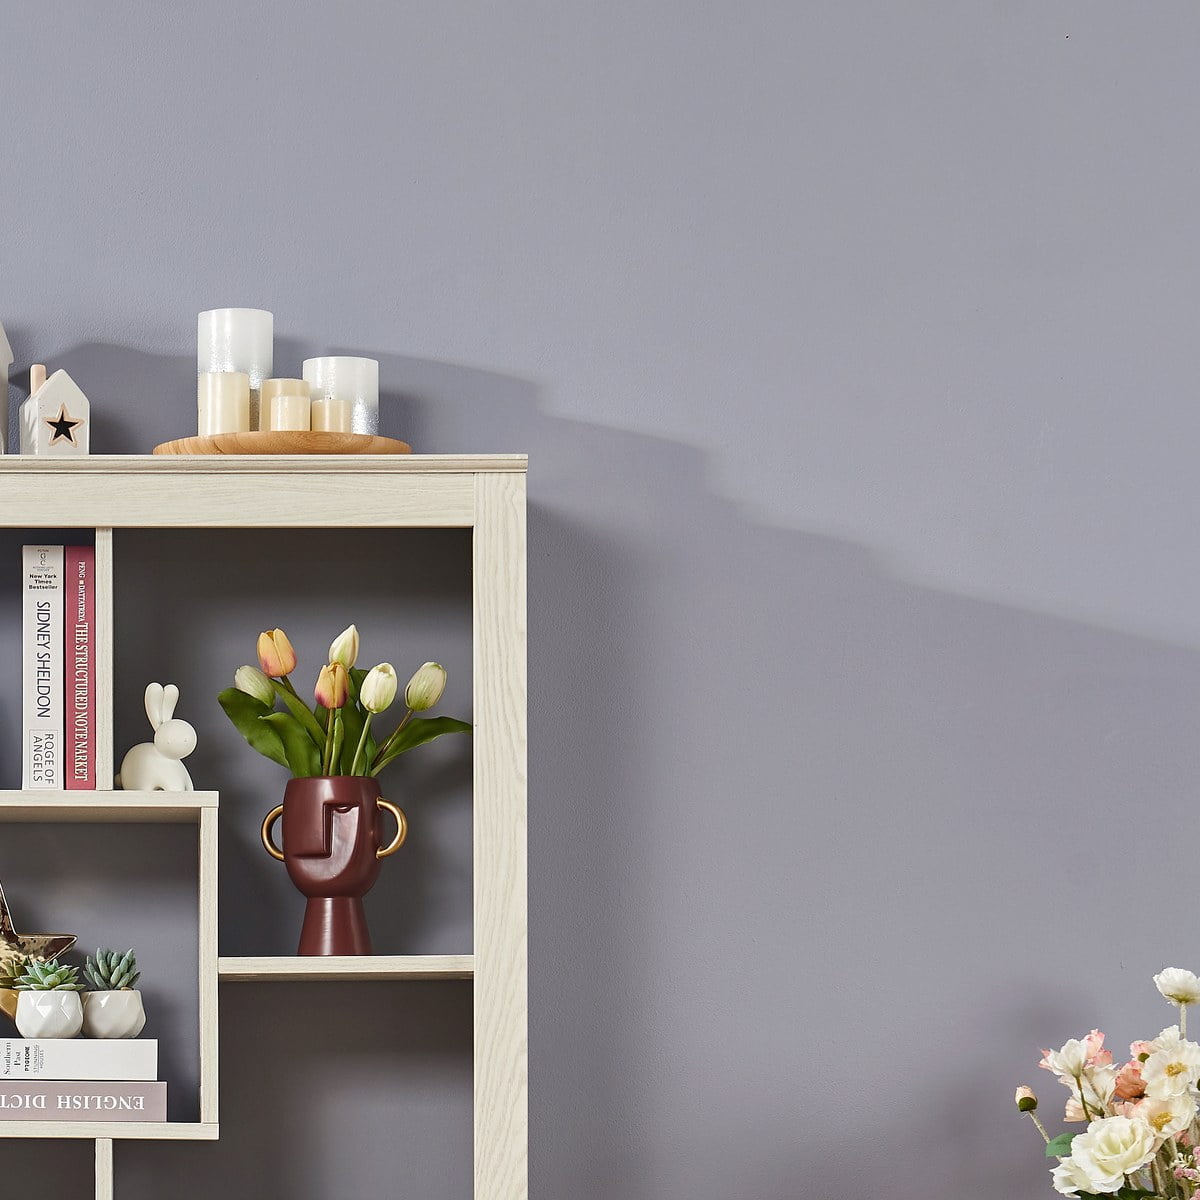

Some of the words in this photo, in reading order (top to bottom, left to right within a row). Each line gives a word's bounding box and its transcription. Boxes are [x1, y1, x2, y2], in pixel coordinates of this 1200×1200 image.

[78, 561, 86, 578] PENG
[36, 601, 51, 650] SIDNEY
[75, 622, 89, 643] THE
[36, 652, 51, 718] SHELDON
[74, 645, 88, 710] STRUCTURED
[74, 712, 88, 740] NOTE
[32, 735, 43, 782] ANGELS
[44, 769, 54, 784] OF
[2, 1042, 11, 1075] Southern
[13, 1051, 21, 1066] Past
[57, 1095, 145, 1110] ENGLISH
